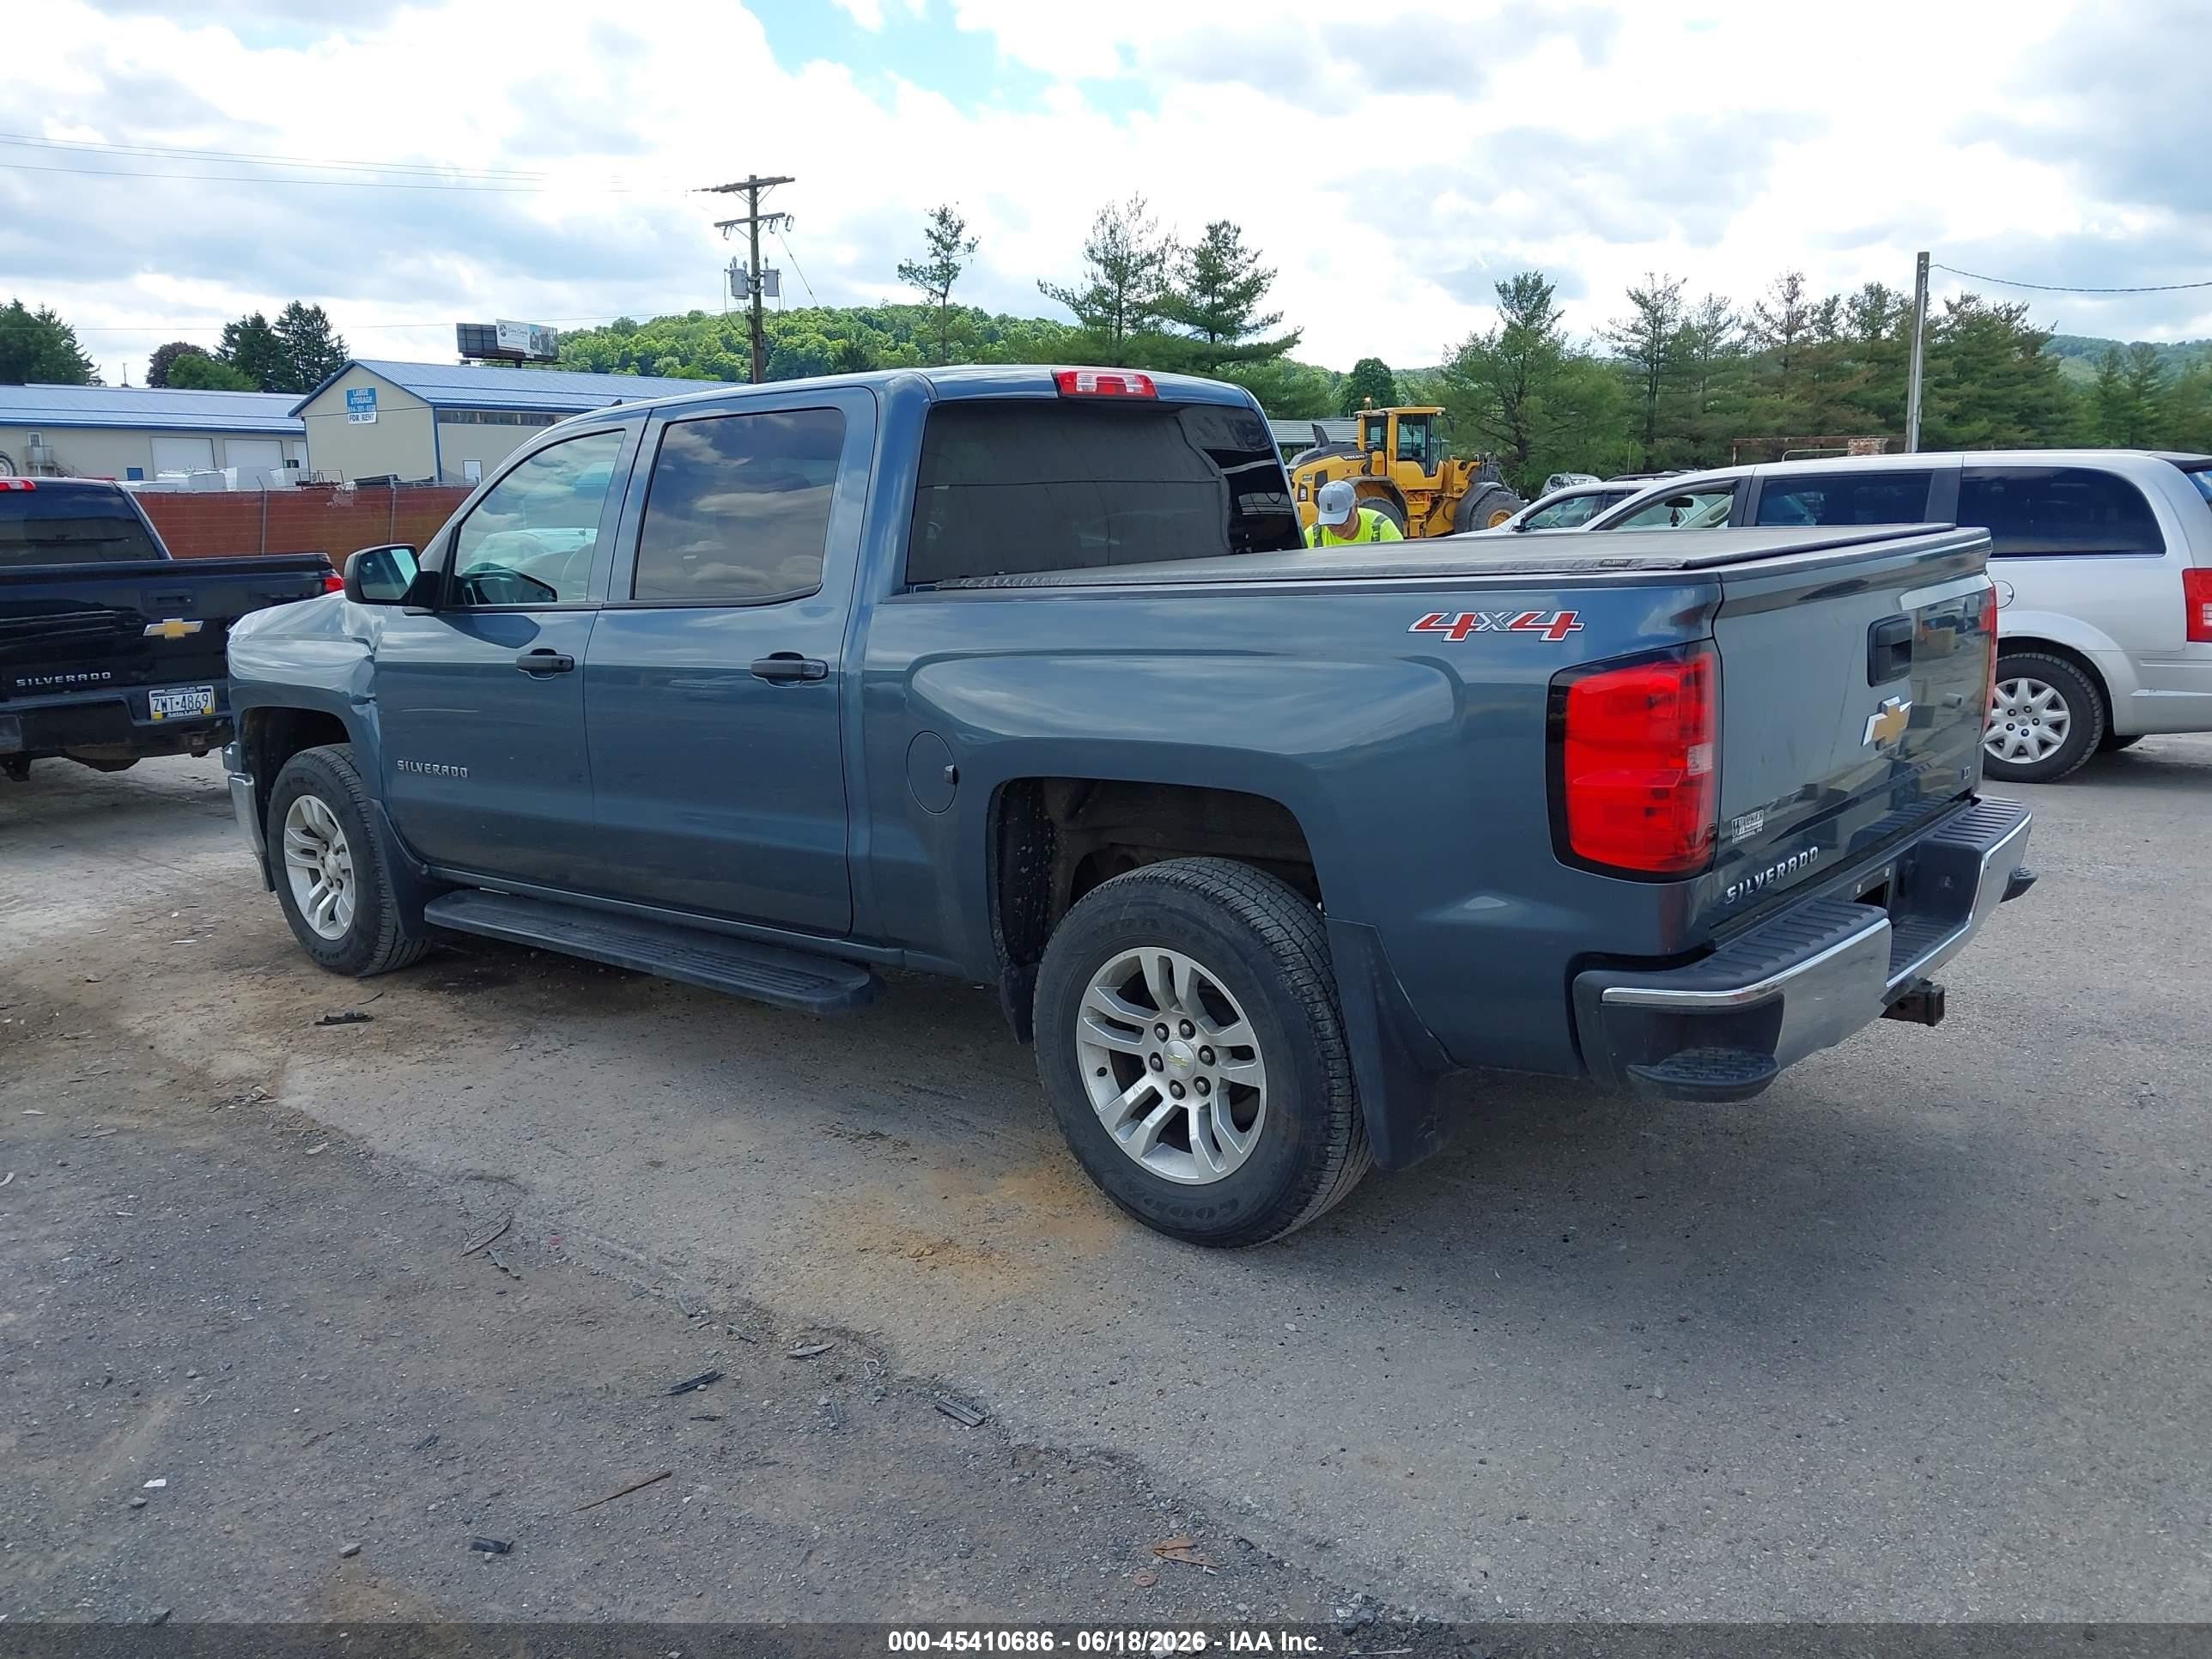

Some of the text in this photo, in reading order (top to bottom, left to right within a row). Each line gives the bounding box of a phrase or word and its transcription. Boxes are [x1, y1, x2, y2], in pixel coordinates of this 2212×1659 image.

[349, 395, 374, 405] STORAGE
[361, 413, 375, 422] RENT
[15, 672, 112, 687] SILVERADO
[397, 760, 468, 778] SILVERADO
[1724, 846, 1819, 904] SILVERADO
